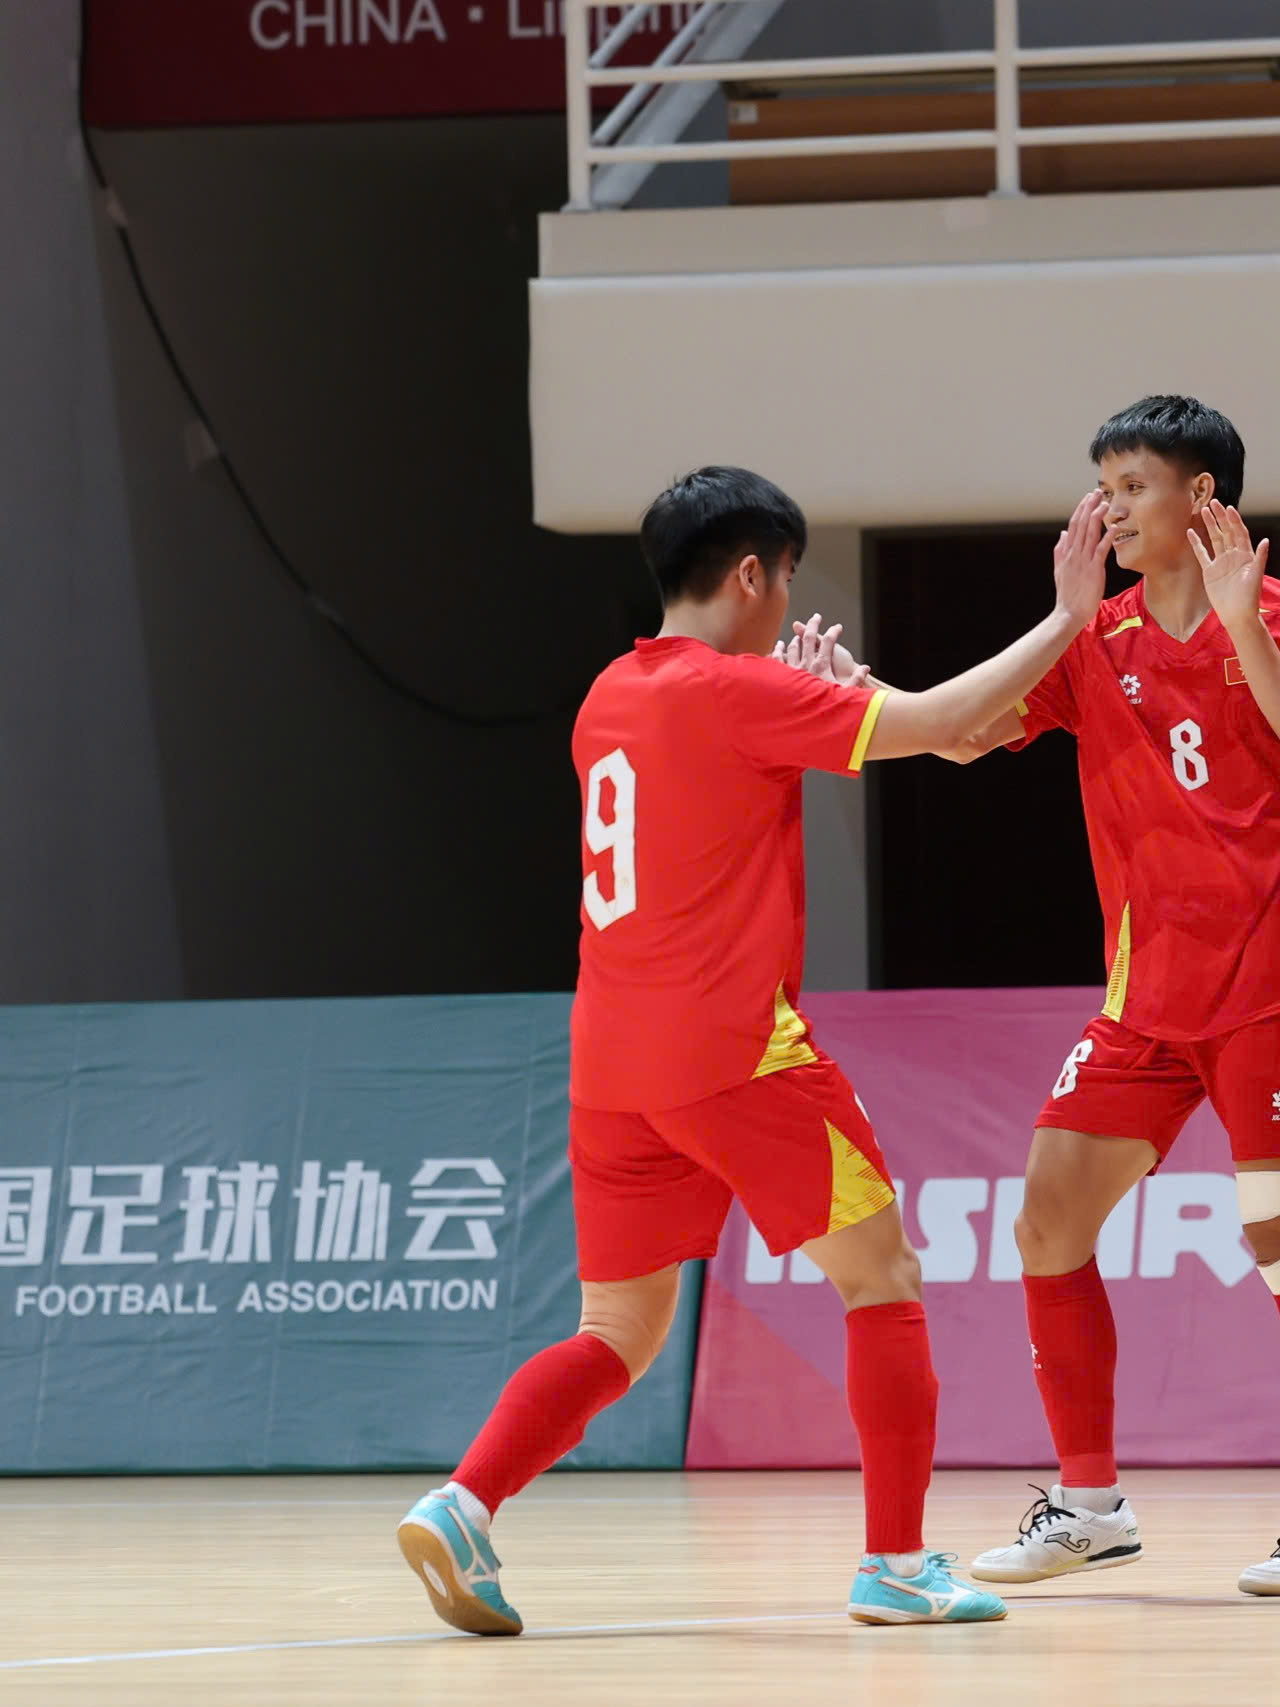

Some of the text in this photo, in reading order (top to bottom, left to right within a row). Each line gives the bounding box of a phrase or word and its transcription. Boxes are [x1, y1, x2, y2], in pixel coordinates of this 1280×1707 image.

[249, 0, 446, 49] CHINA
[1169, 718, 1210, 792] 8
[583, 746, 637, 932] 9
[1051, 1038, 1094, 1100] 8
[15, 1280, 498, 1317] FOOTBALL ASSOCIATION
